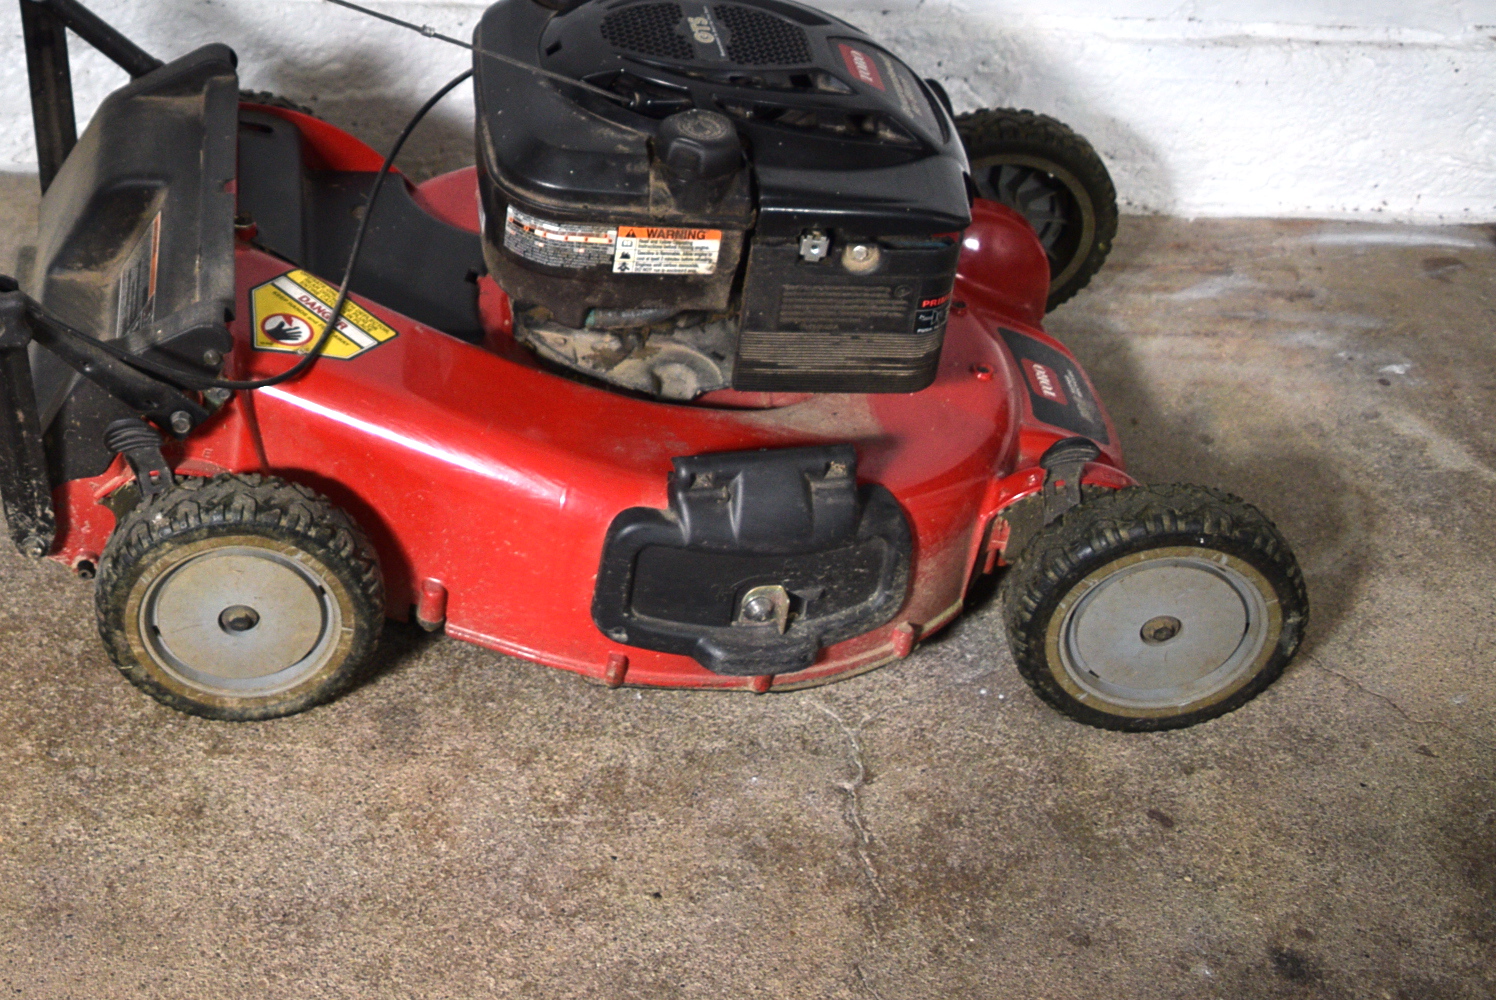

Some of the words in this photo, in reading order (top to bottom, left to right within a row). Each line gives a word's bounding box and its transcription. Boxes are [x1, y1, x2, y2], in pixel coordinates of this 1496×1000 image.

[850, 50, 872, 82] TORO
[647, 229, 706, 240] WARNING
[297, 294, 349, 330] DANGR
[1033, 363, 1056, 397] TORO
